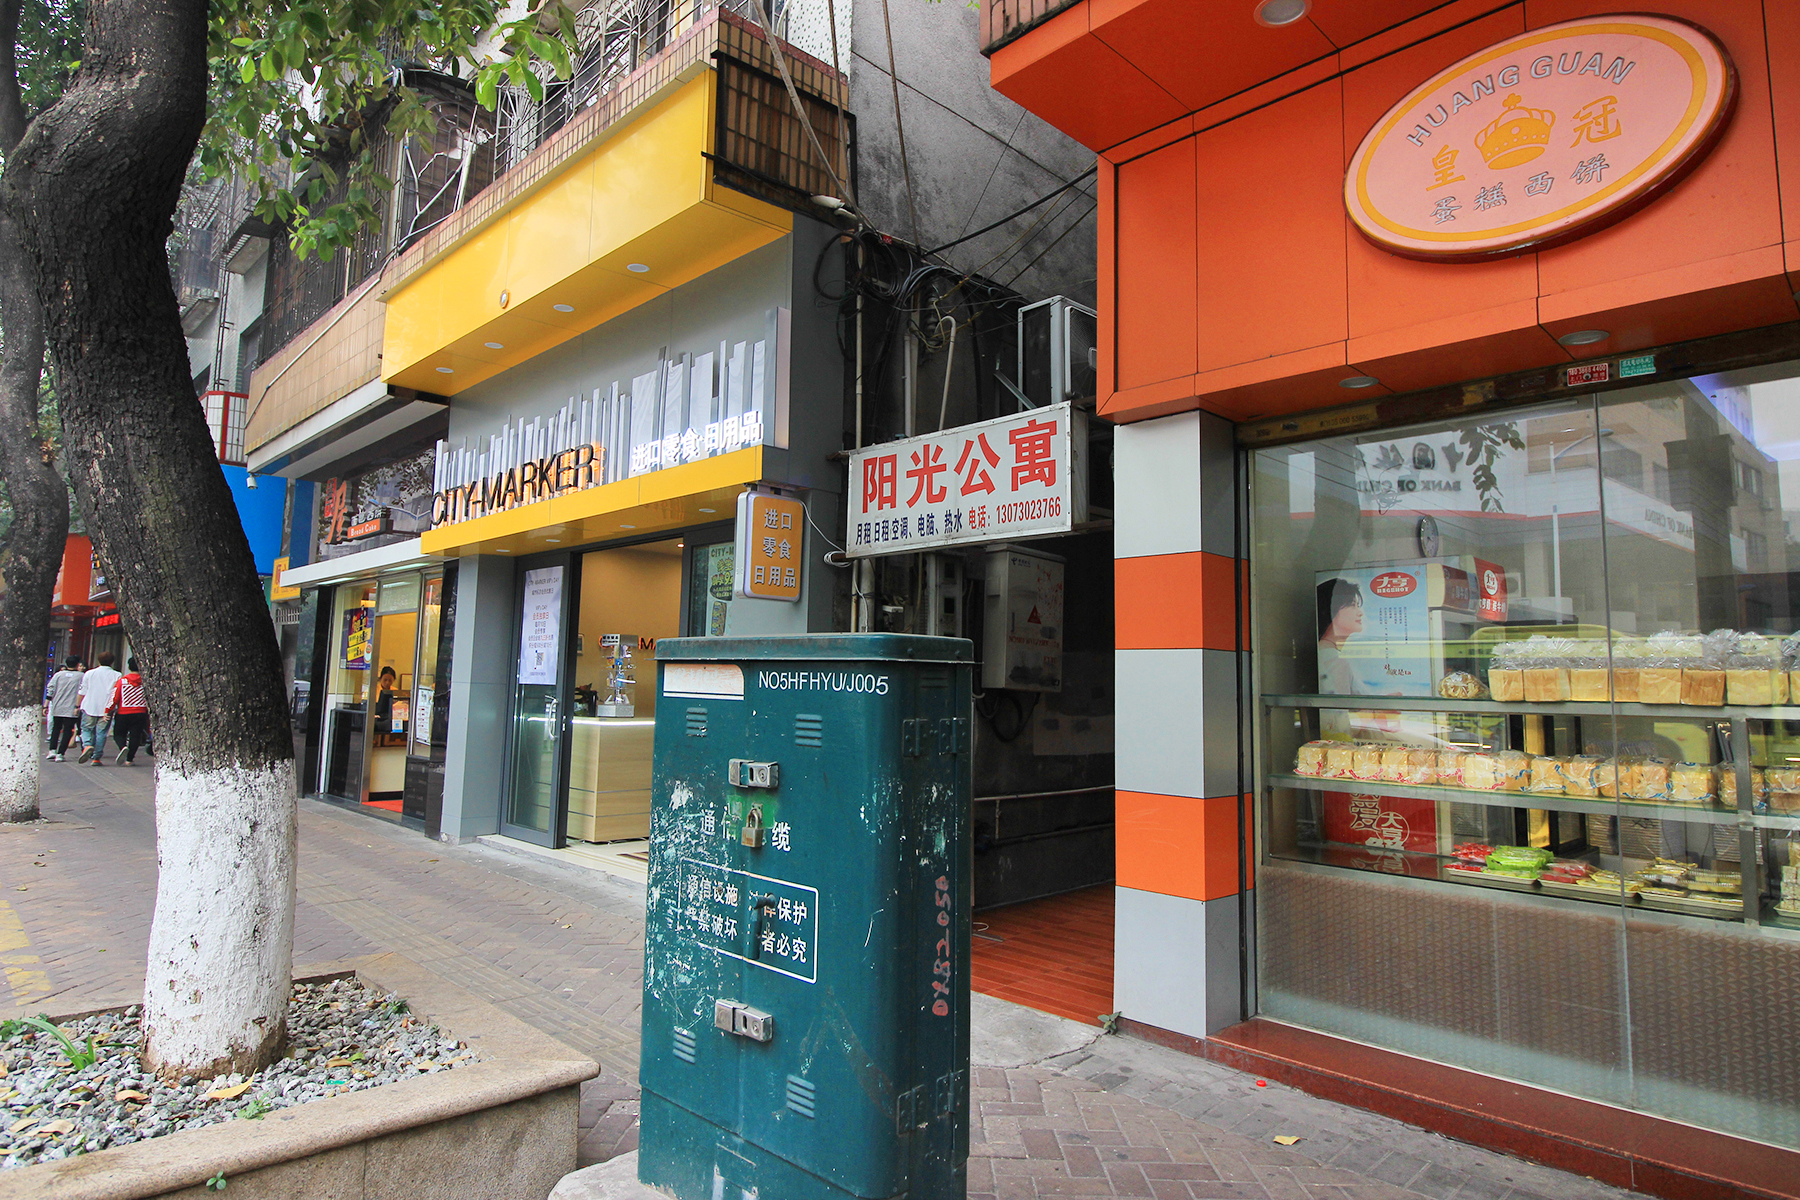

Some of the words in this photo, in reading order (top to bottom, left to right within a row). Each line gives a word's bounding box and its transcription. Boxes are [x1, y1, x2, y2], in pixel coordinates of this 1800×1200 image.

[1406, 65, 1521, 148] HUANG
[1530, 51, 1636, 85] GUAN
[1426, 144, 1466, 192] 皇
[1569, 95, 1623, 149] 冠
[1429, 153, 1610, 226] 蛋糕西饼
[430, 443, 598, 527] CITY-MARKER
[861, 418, 1058, 514] 阳光公寓
[350, 528, 364, 537] Bread
[365, 523, 377, 533] Cake
[763, 508, 793, 531] 进口
[763, 536, 792, 560] 零食
[754, 565, 796, 588] 日用品
